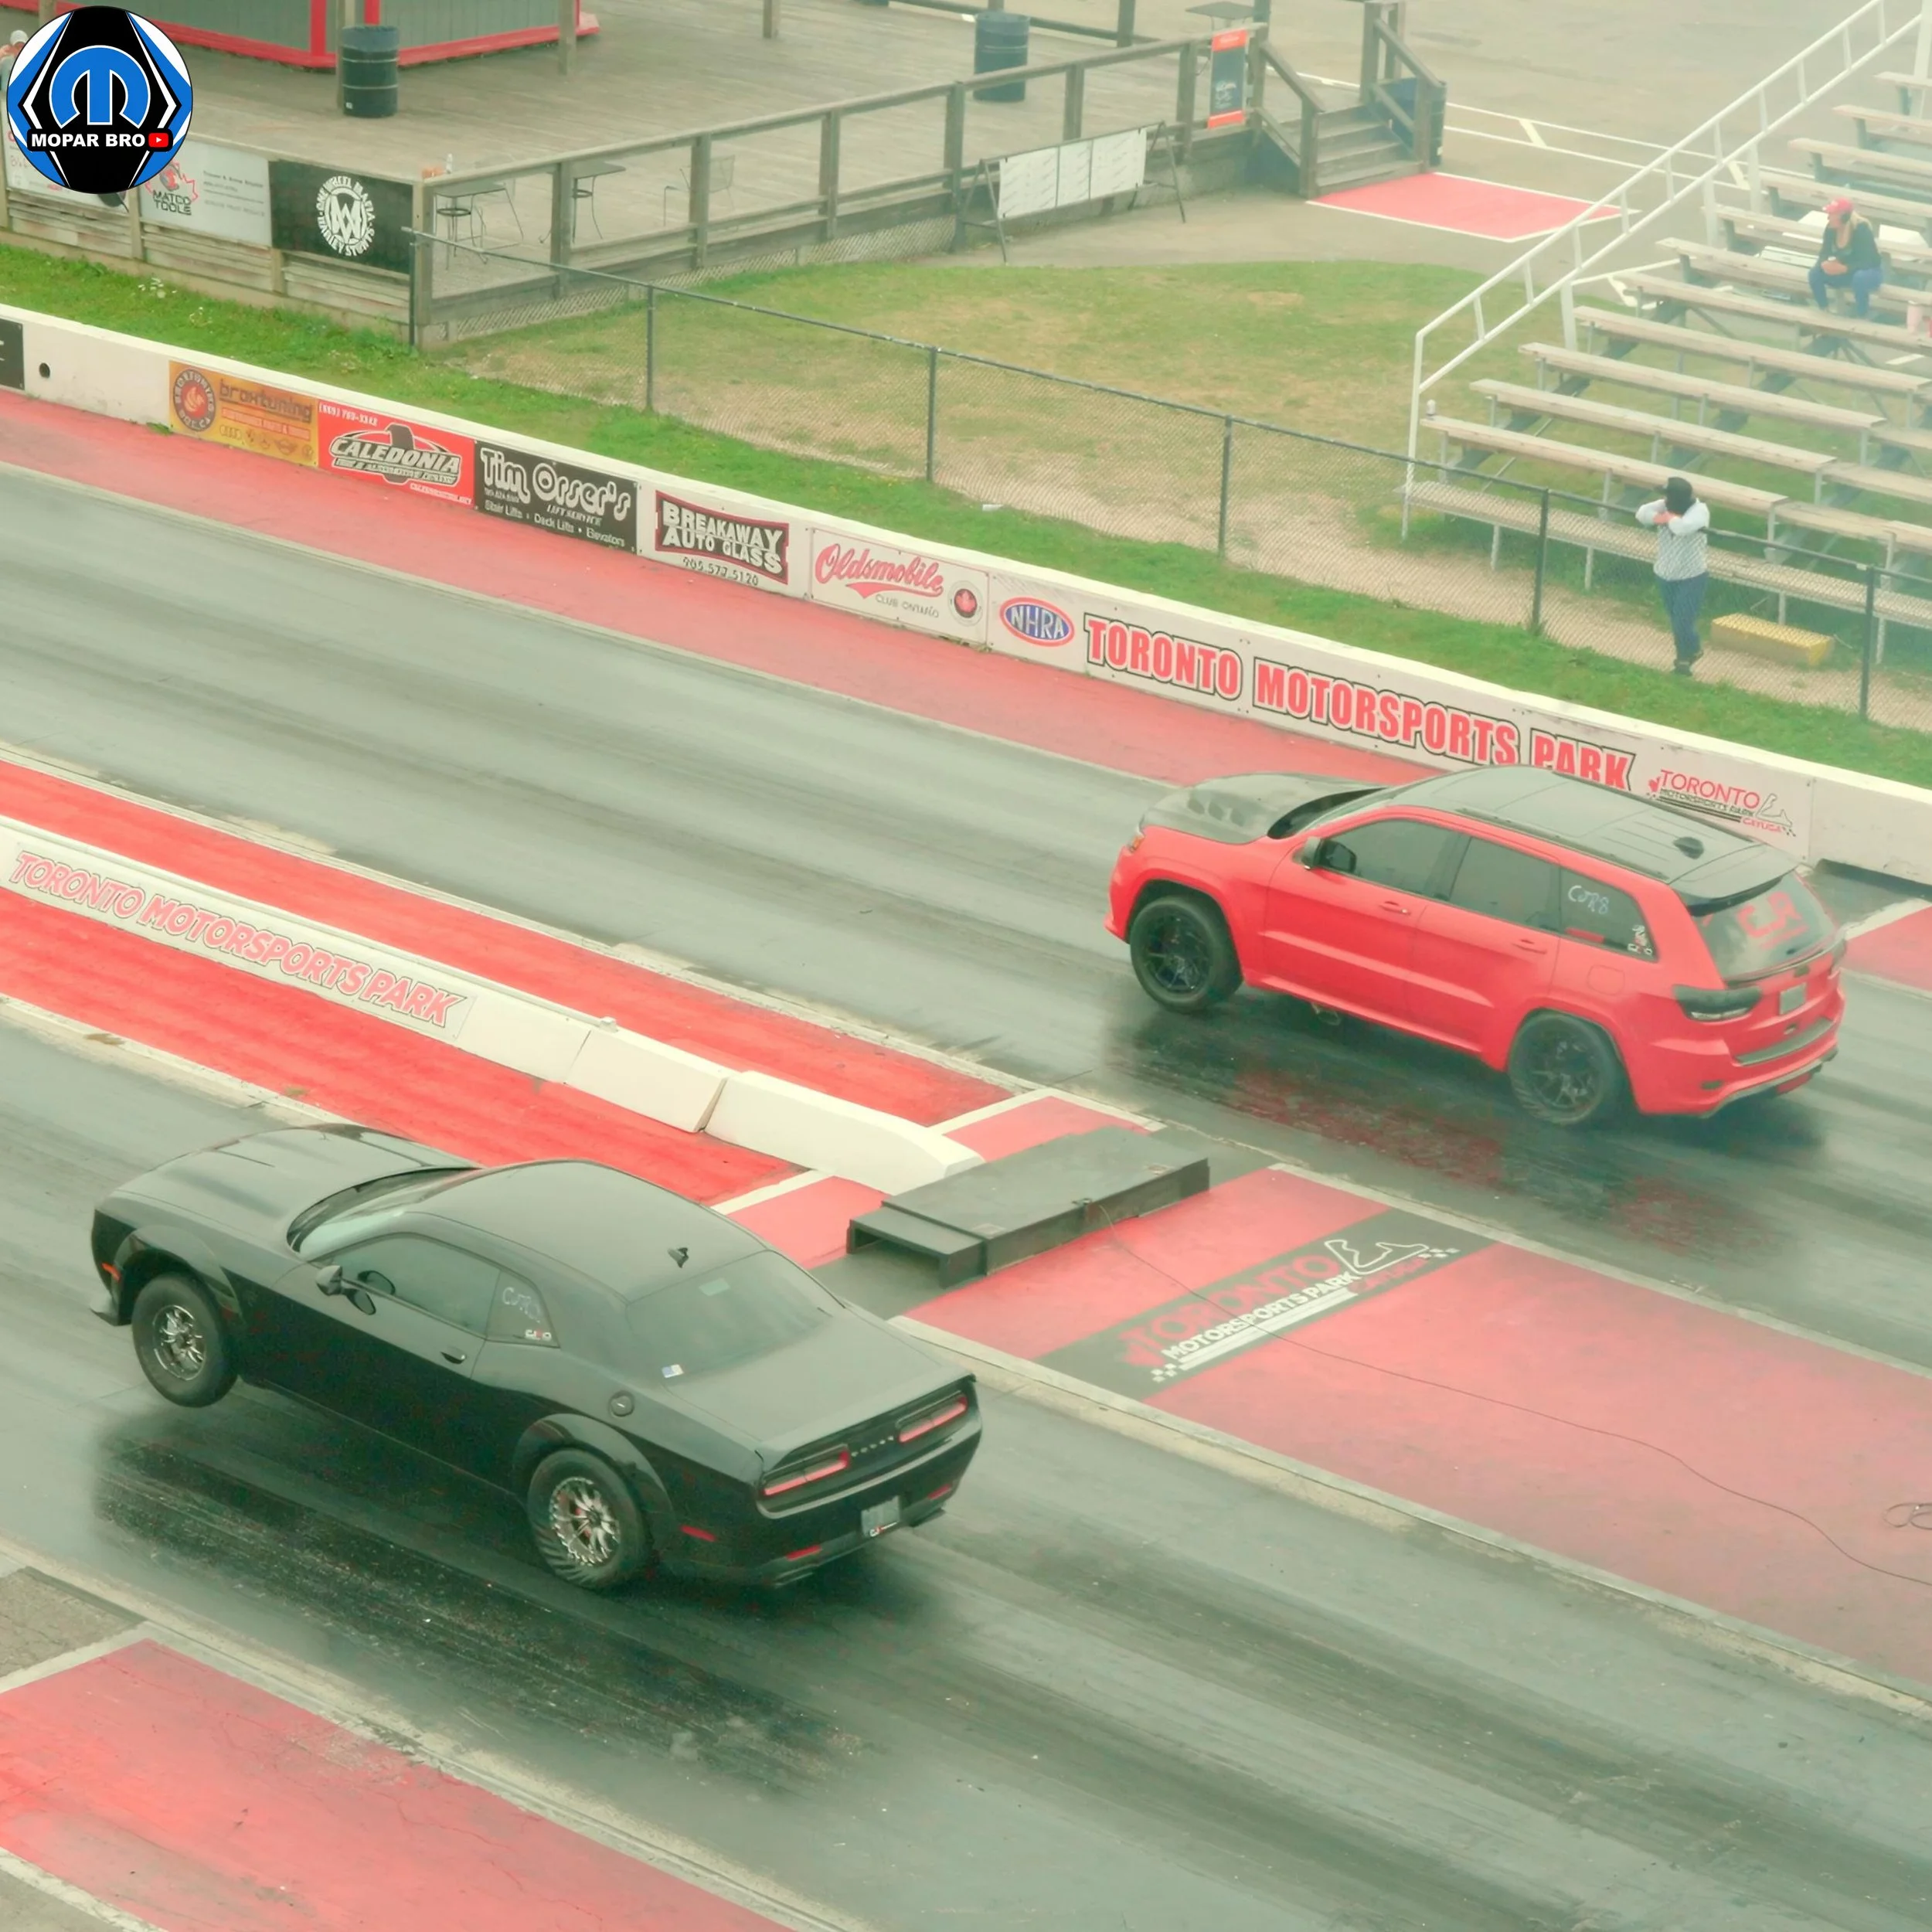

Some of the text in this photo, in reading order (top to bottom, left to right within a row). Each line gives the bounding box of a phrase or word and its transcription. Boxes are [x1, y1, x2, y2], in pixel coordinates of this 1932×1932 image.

[153, 190, 192, 206] MATCO
[330, 436, 461, 476] CALEDONIA
[481, 447, 531, 504] Tim
[662, 500, 783, 555] BREAKAWAY
[662, 524, 783, 574] AUTO GLASS
[815, 543, 944, 592] Oldsmobile
[1010, 605, 1065, 639] NHRA
[1083, 613, 1637, 791] TORONTO MOTORSPORTS PARK
[1660, 769, 1760, 809] TORONTO
[9, 850, 468, 1028] TORONTO MOTORSPORTS PARK
[1121, 1253, 1342, 1349] TORONTO
[1162, 1294, 1310, 1359] MOTORSPORTS
[1302, 1270, 1362, 1301] PARK
